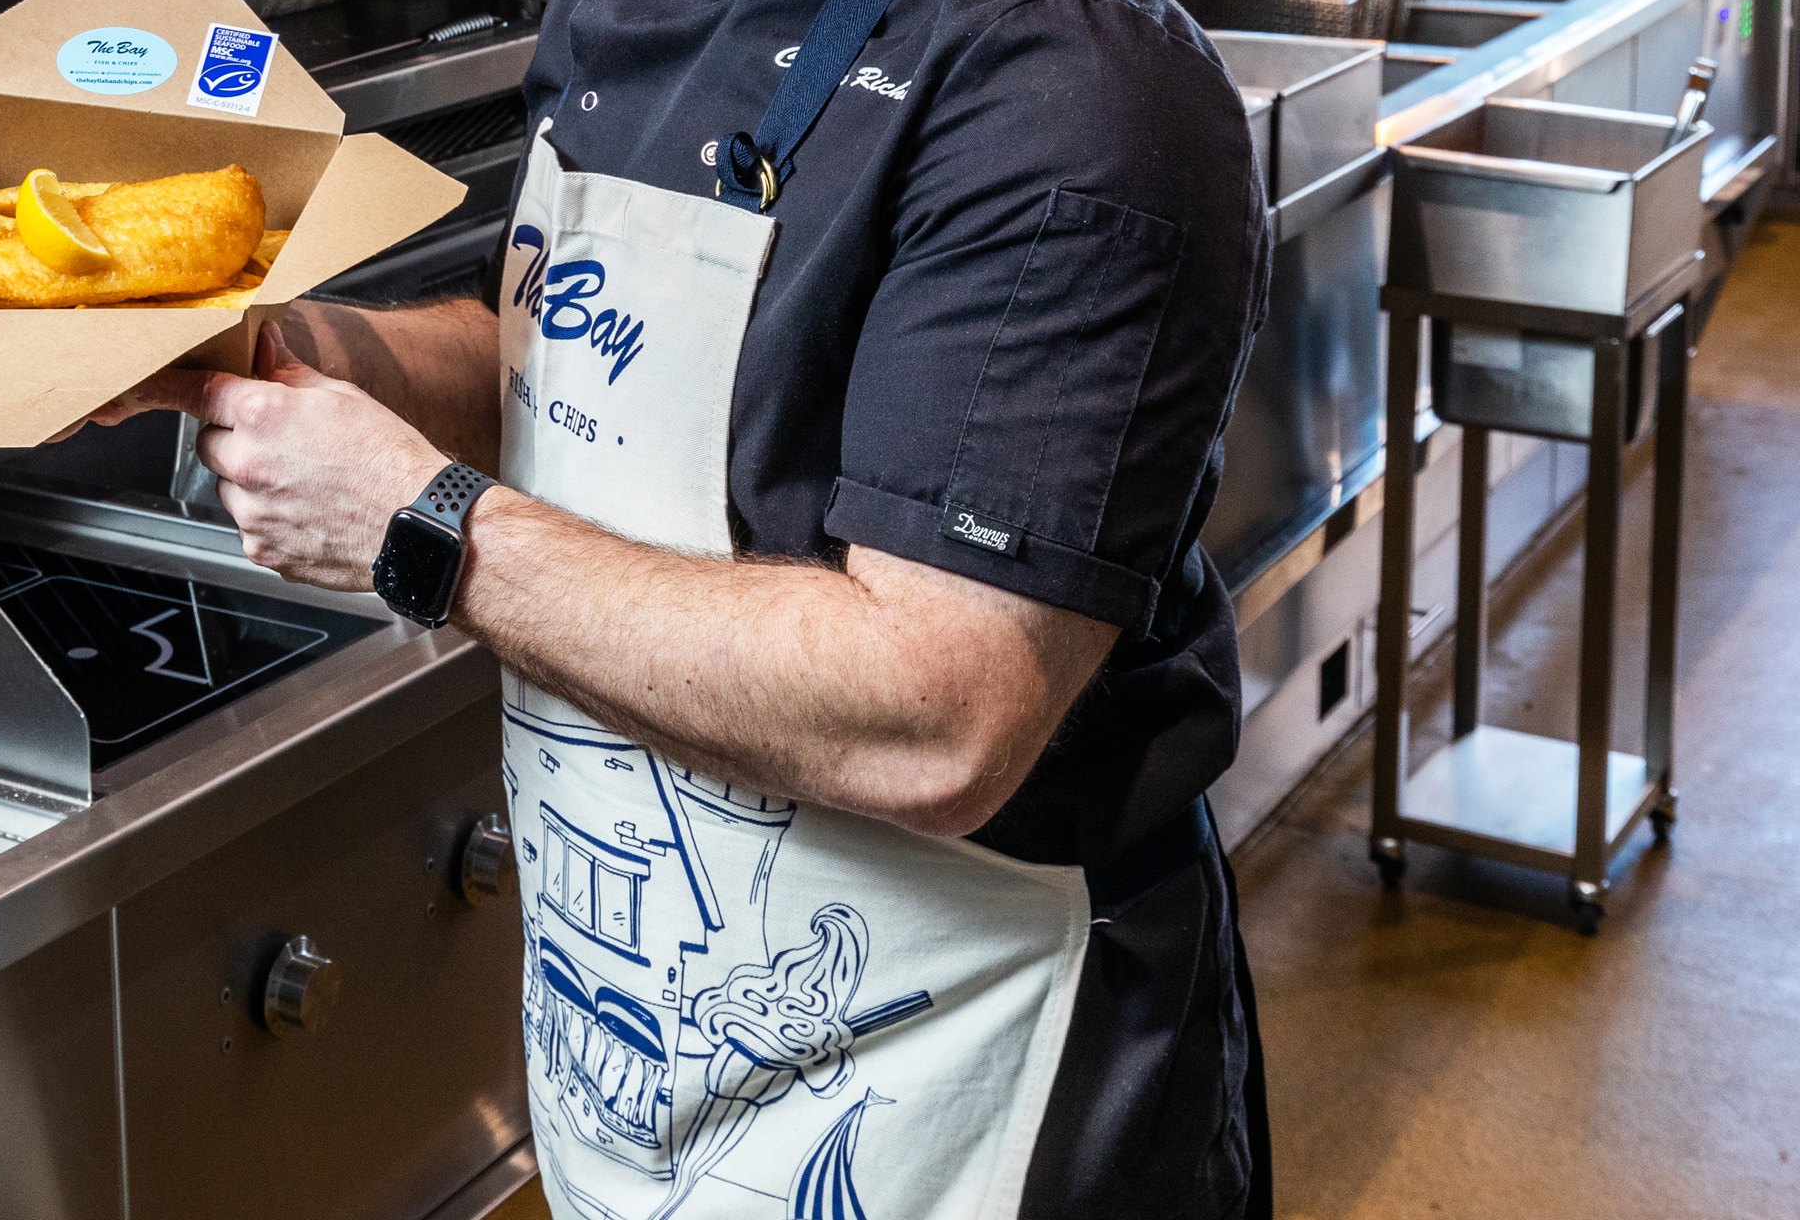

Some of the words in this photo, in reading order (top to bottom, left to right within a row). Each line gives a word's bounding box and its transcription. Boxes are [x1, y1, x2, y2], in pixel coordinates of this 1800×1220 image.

[214, 34, 261, 48] SUSTAINABLE
[216, 29, 251, 40] CERTIFIED
[87, 40, 114, 54] The
[116, 41, 148, 58] Bay
[210, 46, 235, 57] MSC
[212, 40, 246, 51] SEAFOOD
[209, 53, 252, 66] www.msc.org
[195, 97, 250, 112] MSC-C-53712-4
[512, 224, 550, 326] Th
[541, 259, 644, 386] Bay
[509, 365, 531, 409] FISH
[548, 400, 598, 444] CHIPS
[953, 513, 1011, 547] Dennys
[964, 534, 994, 547] LONDON
